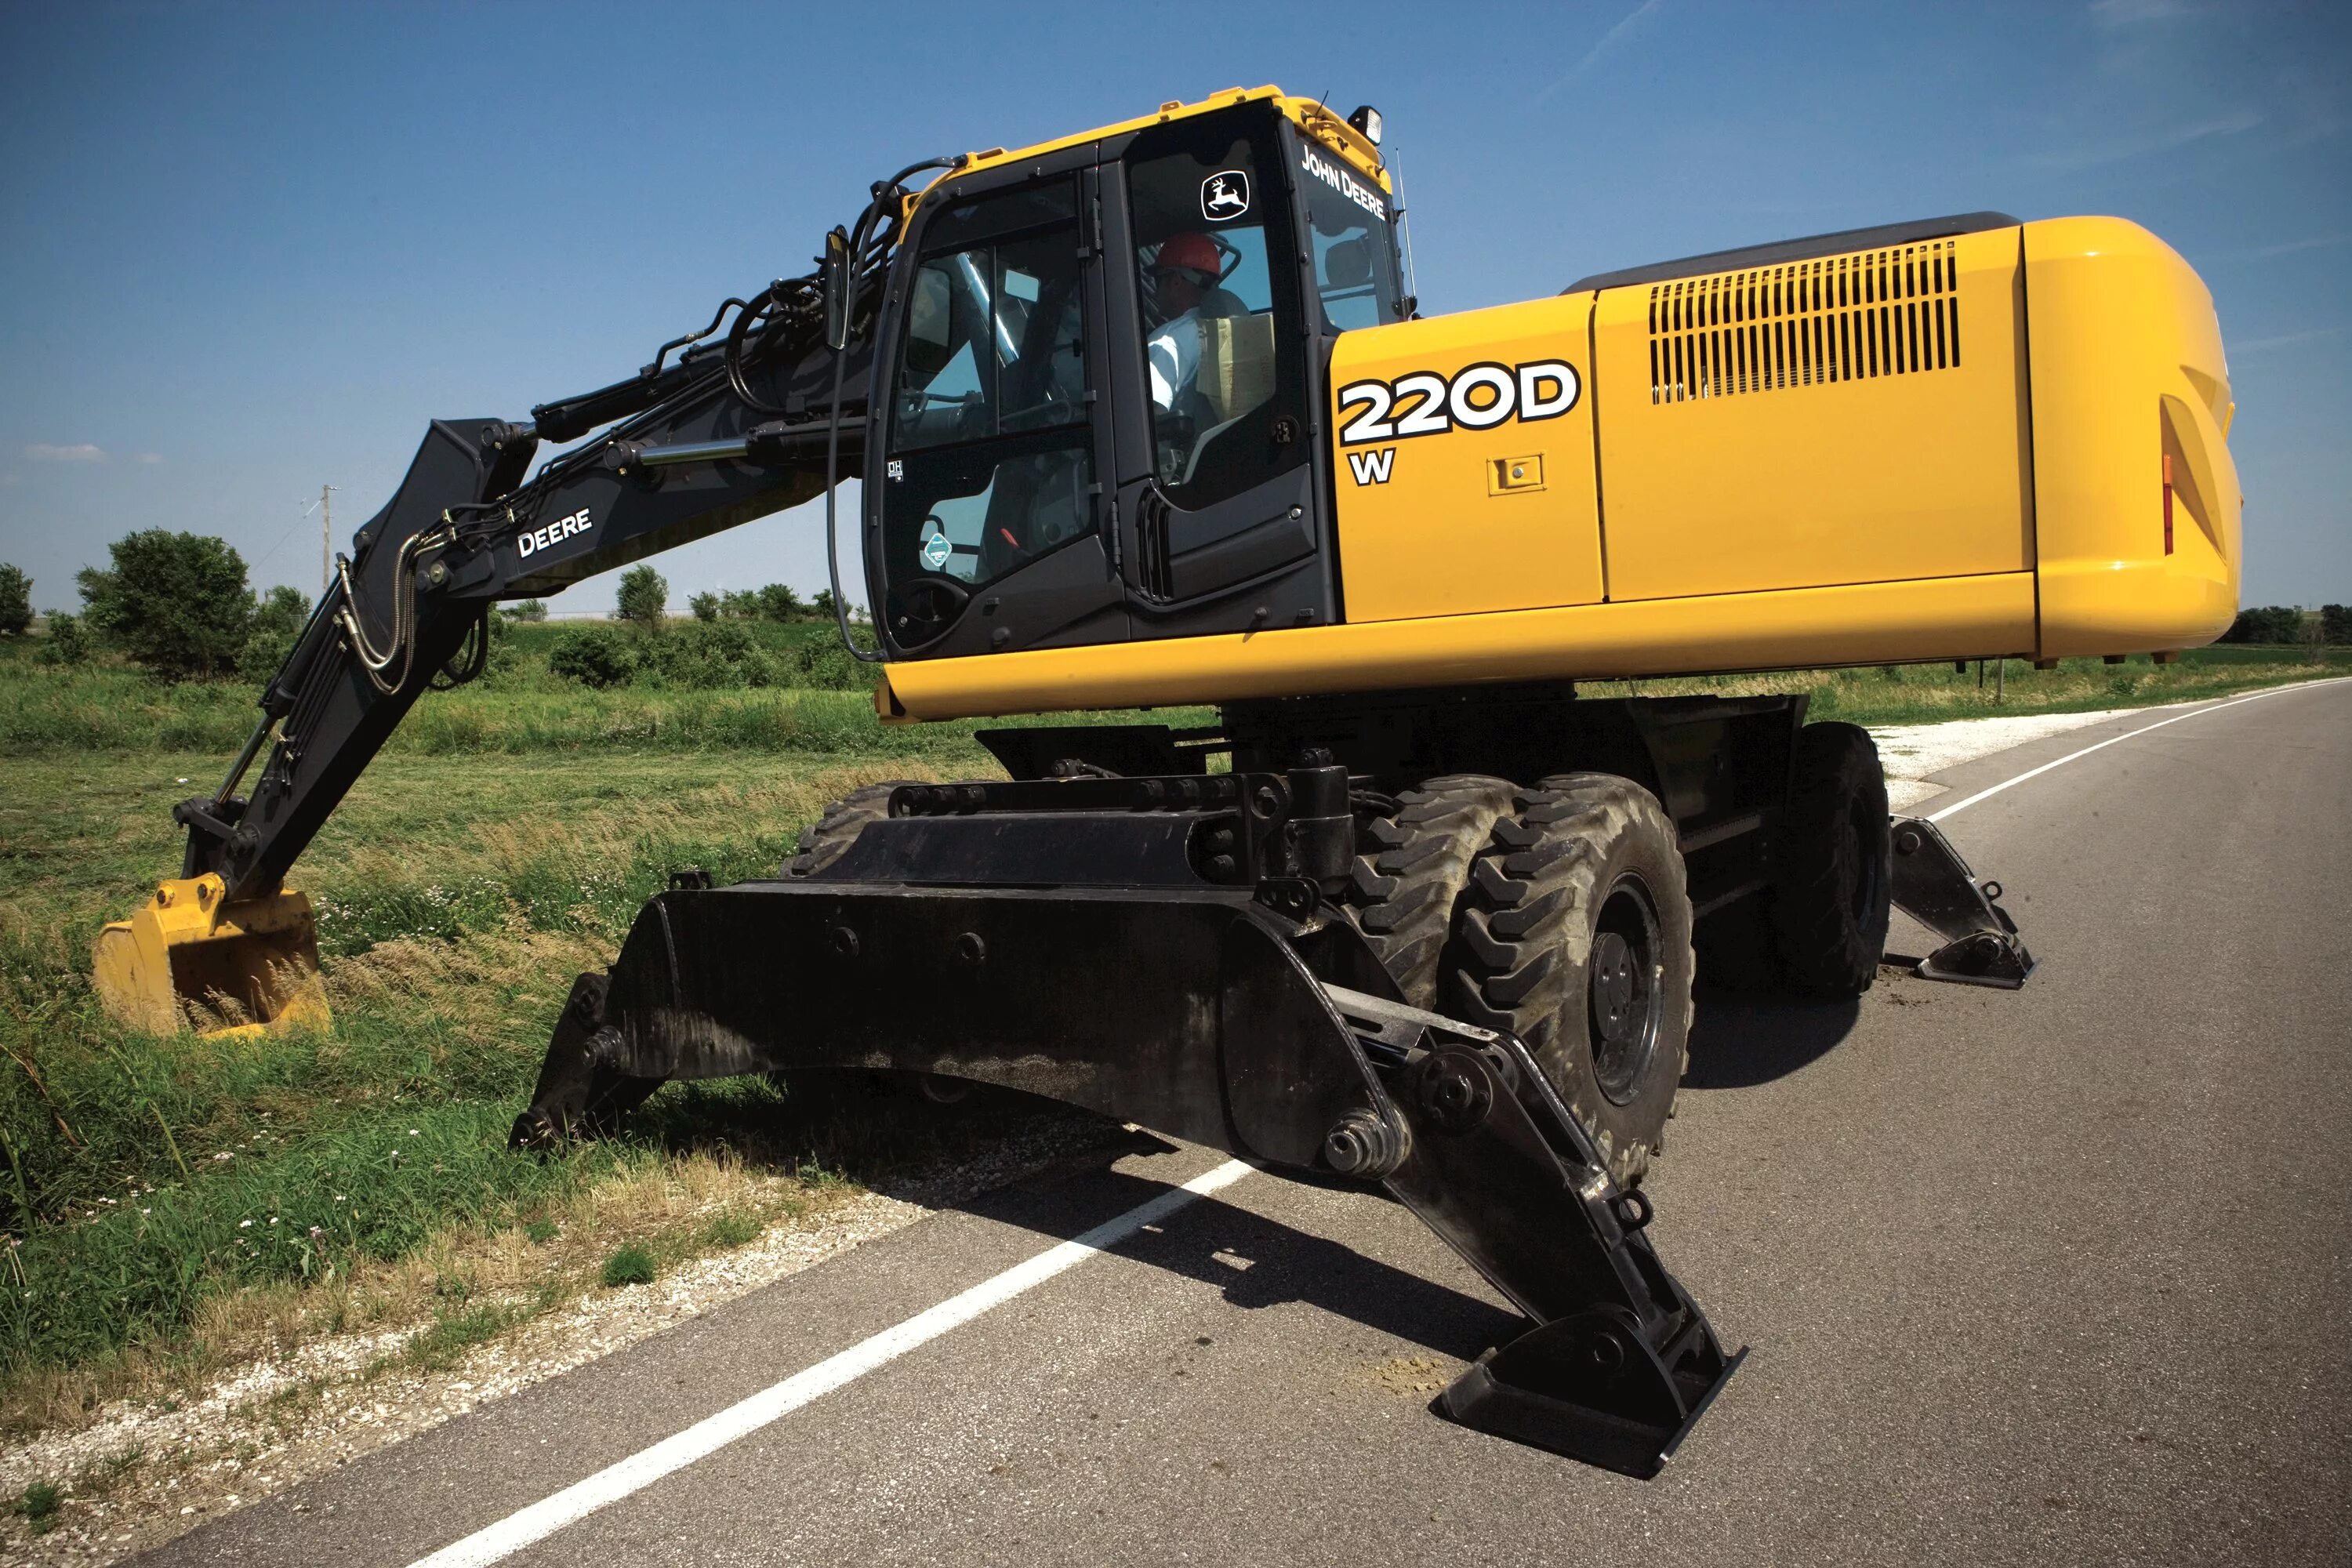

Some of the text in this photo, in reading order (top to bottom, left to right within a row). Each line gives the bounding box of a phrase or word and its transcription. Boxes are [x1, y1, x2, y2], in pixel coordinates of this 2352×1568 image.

[1301, 144, 1385, 221] JOHN DEERE
[1338, 359, 1581, 446] 220D
[1347, 448, 1396, 485] W
[517, 508, 593, 558] DEERE
